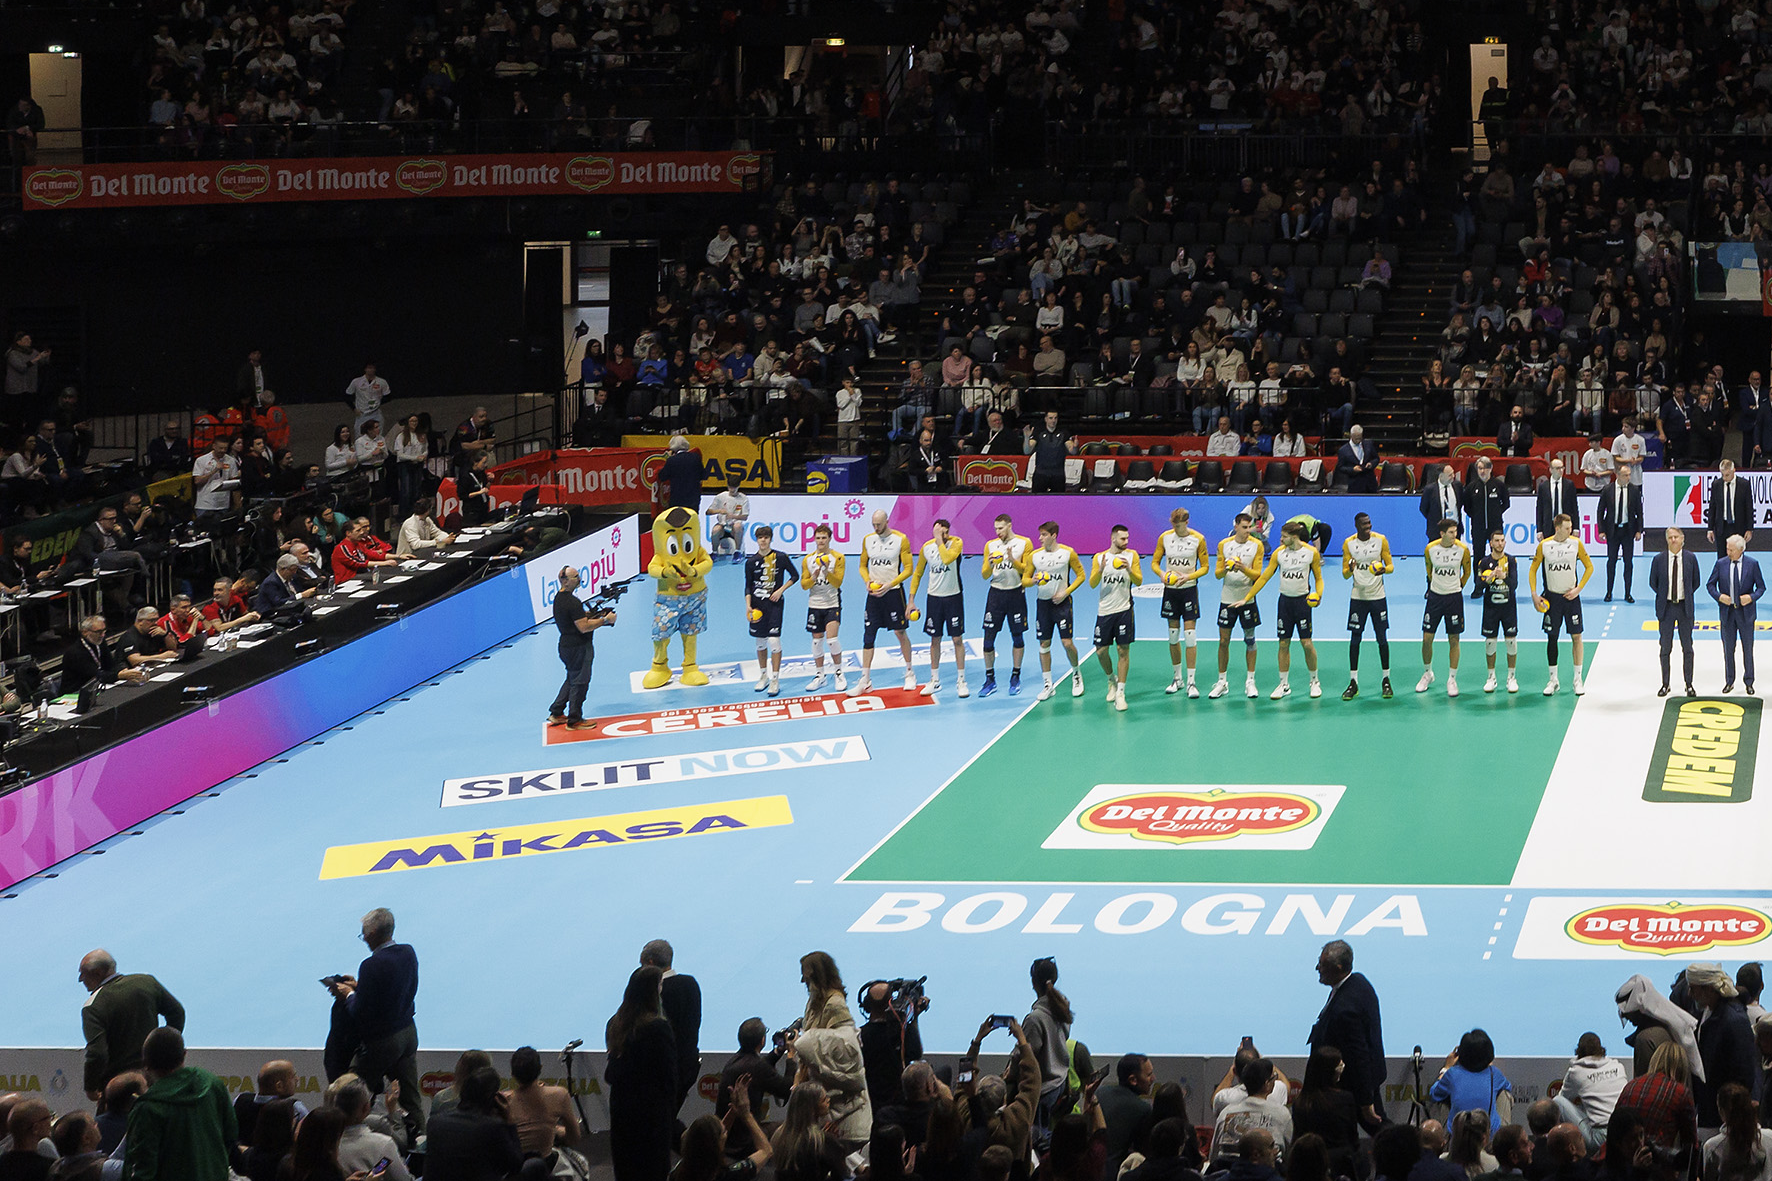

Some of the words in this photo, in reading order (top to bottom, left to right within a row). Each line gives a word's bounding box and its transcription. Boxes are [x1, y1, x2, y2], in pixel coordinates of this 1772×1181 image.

[90, 172, 129, 197] Del
[132, 171, 210, 196] Monte
[276, 168, 312, 191] Del
[317, 168, 390, 190] Monte
[453, 165, 488, 187] Del
[491, 164, 560, 186] Monte
[620, 163, 653, 184] Del
[657, 162, 721, 183] Monte
[559, 465, 639, 493] Monte
[701, 458, 771, 482] ASA
[967, 473, 981, 485] Del
[983, 473, 1013, 485] Monte
[601, 696, 887, 737] CERELIA
[1662, 701, 1744, 798] CREDEM
[458, 760, 665, 802] SKI.IT
[680, 741, 850, 776] NOW
[1102, 804, 1168, 822] Del
[1172, 804, 1303, 822] Monte
[1147, 819, 1234, 833] Quality
[846, 892, 1428, 937] BOLOGNA
[1584, 916, 1644, 934] Del
[1648, 916, 1760, 936] Monte
[1630, 931, 1697, 947] Quality
